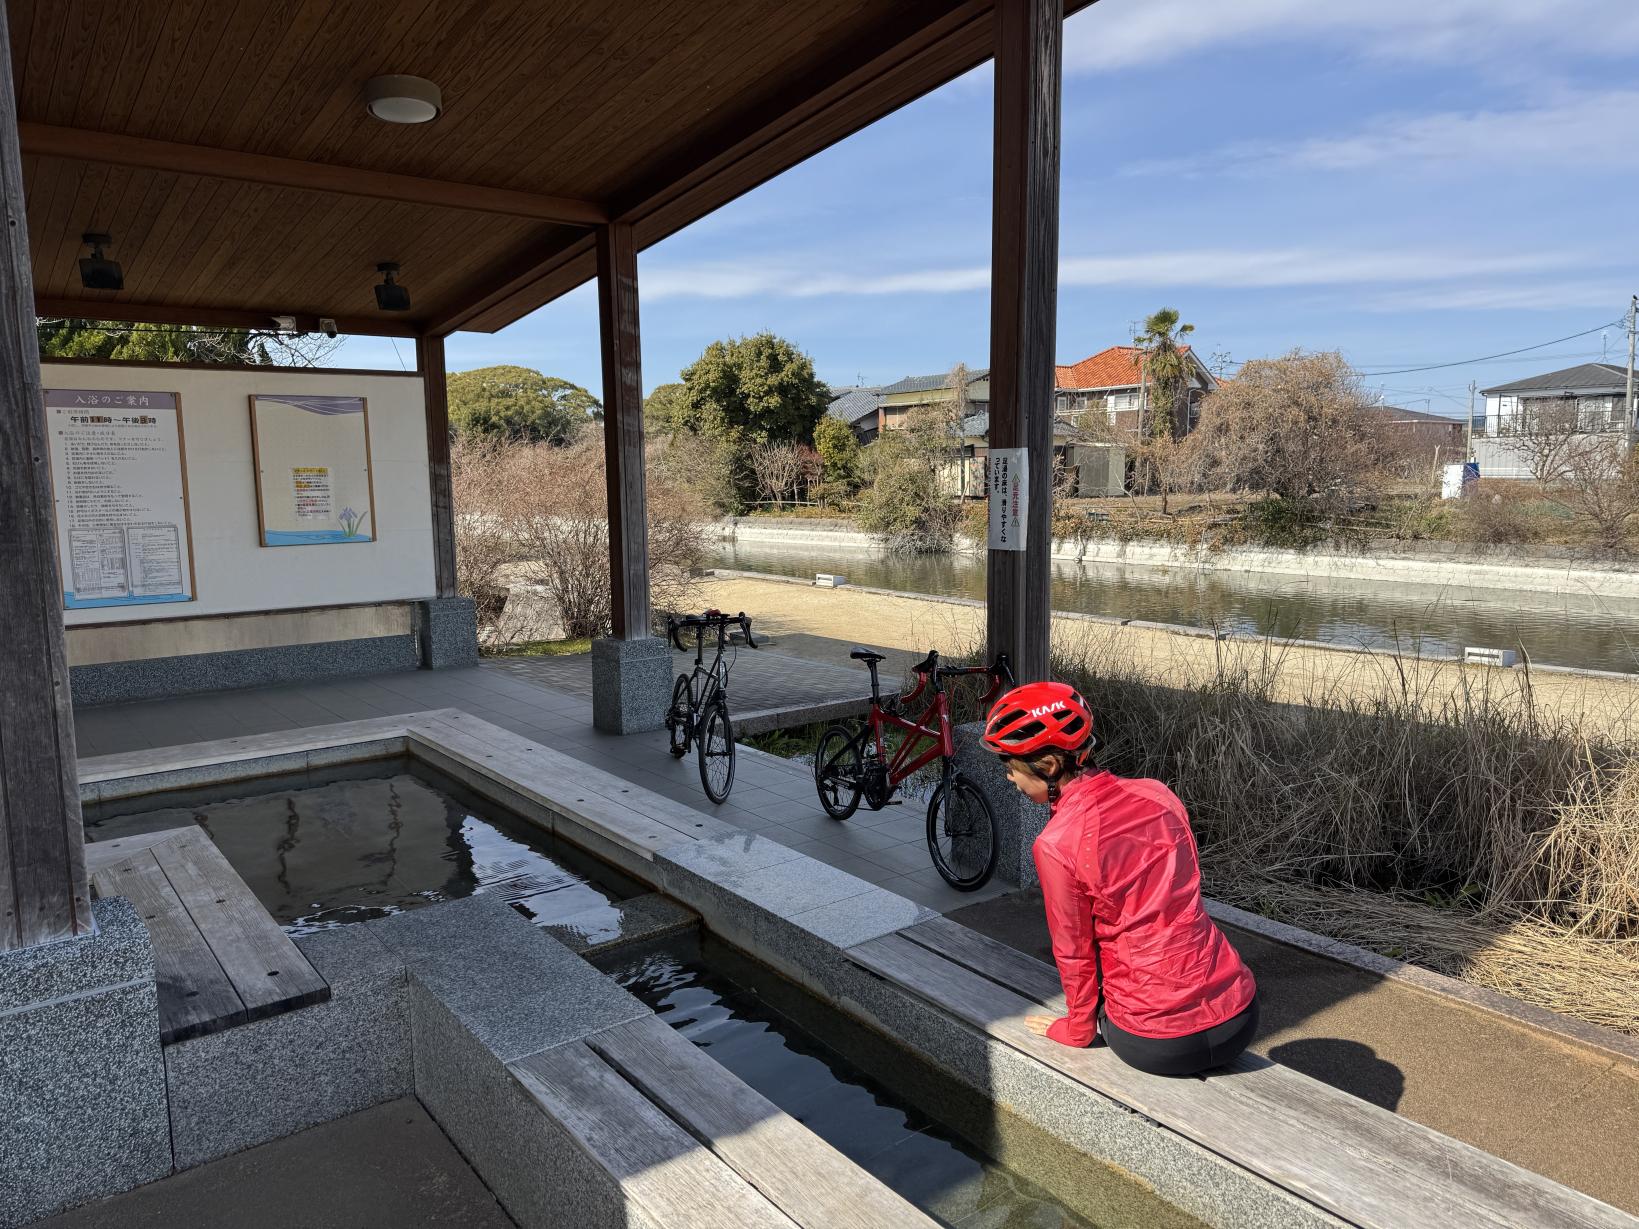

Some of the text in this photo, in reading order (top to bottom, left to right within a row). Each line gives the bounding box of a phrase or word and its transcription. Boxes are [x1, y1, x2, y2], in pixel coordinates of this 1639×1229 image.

[75, 395, 150, 406] 入浴のご案内
[1031, 700, 1067, 718] KASK
